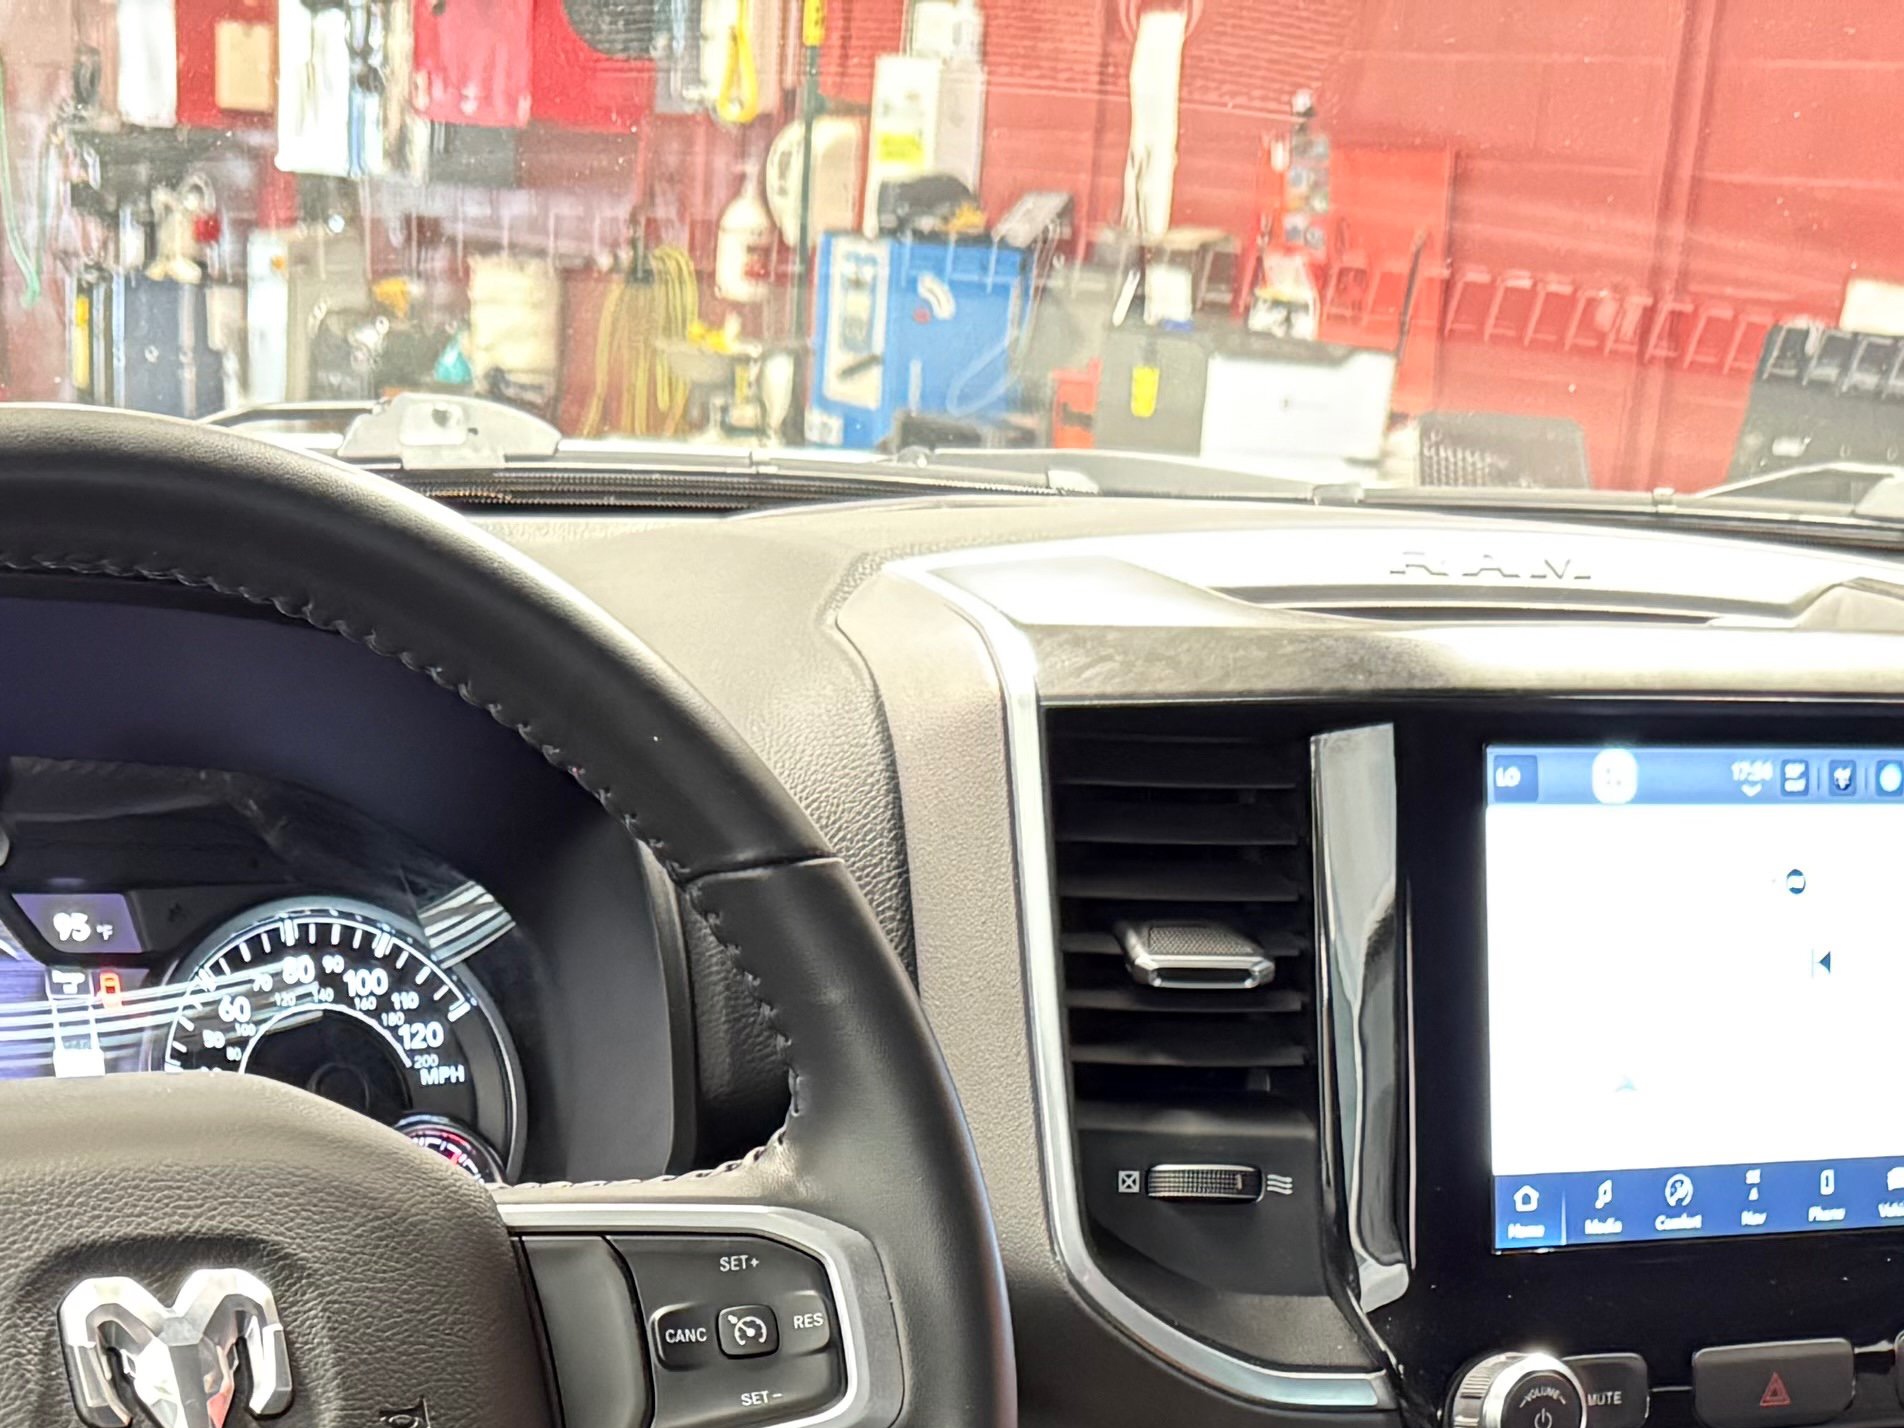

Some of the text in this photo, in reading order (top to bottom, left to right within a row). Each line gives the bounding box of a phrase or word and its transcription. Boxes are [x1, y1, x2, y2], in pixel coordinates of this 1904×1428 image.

[281, 954, 316, 984] 80
[342, 968, 389, 997] 100
[218, 996, 252, 1023] 60
[398, 1021, 444, 1050] 120
[414, 1054, 439, 1069] 200
[420, 1064, 465, 1086] MPH
[719, 1255, 760, 1272] SET+
[793, 1313, 824, 1330] RES
[665, 1327, 708, 1344] CANC
[1524, 1386, 1561, 1402] VOLUME
[1587, 1391, 1622, 1407] MUTE
